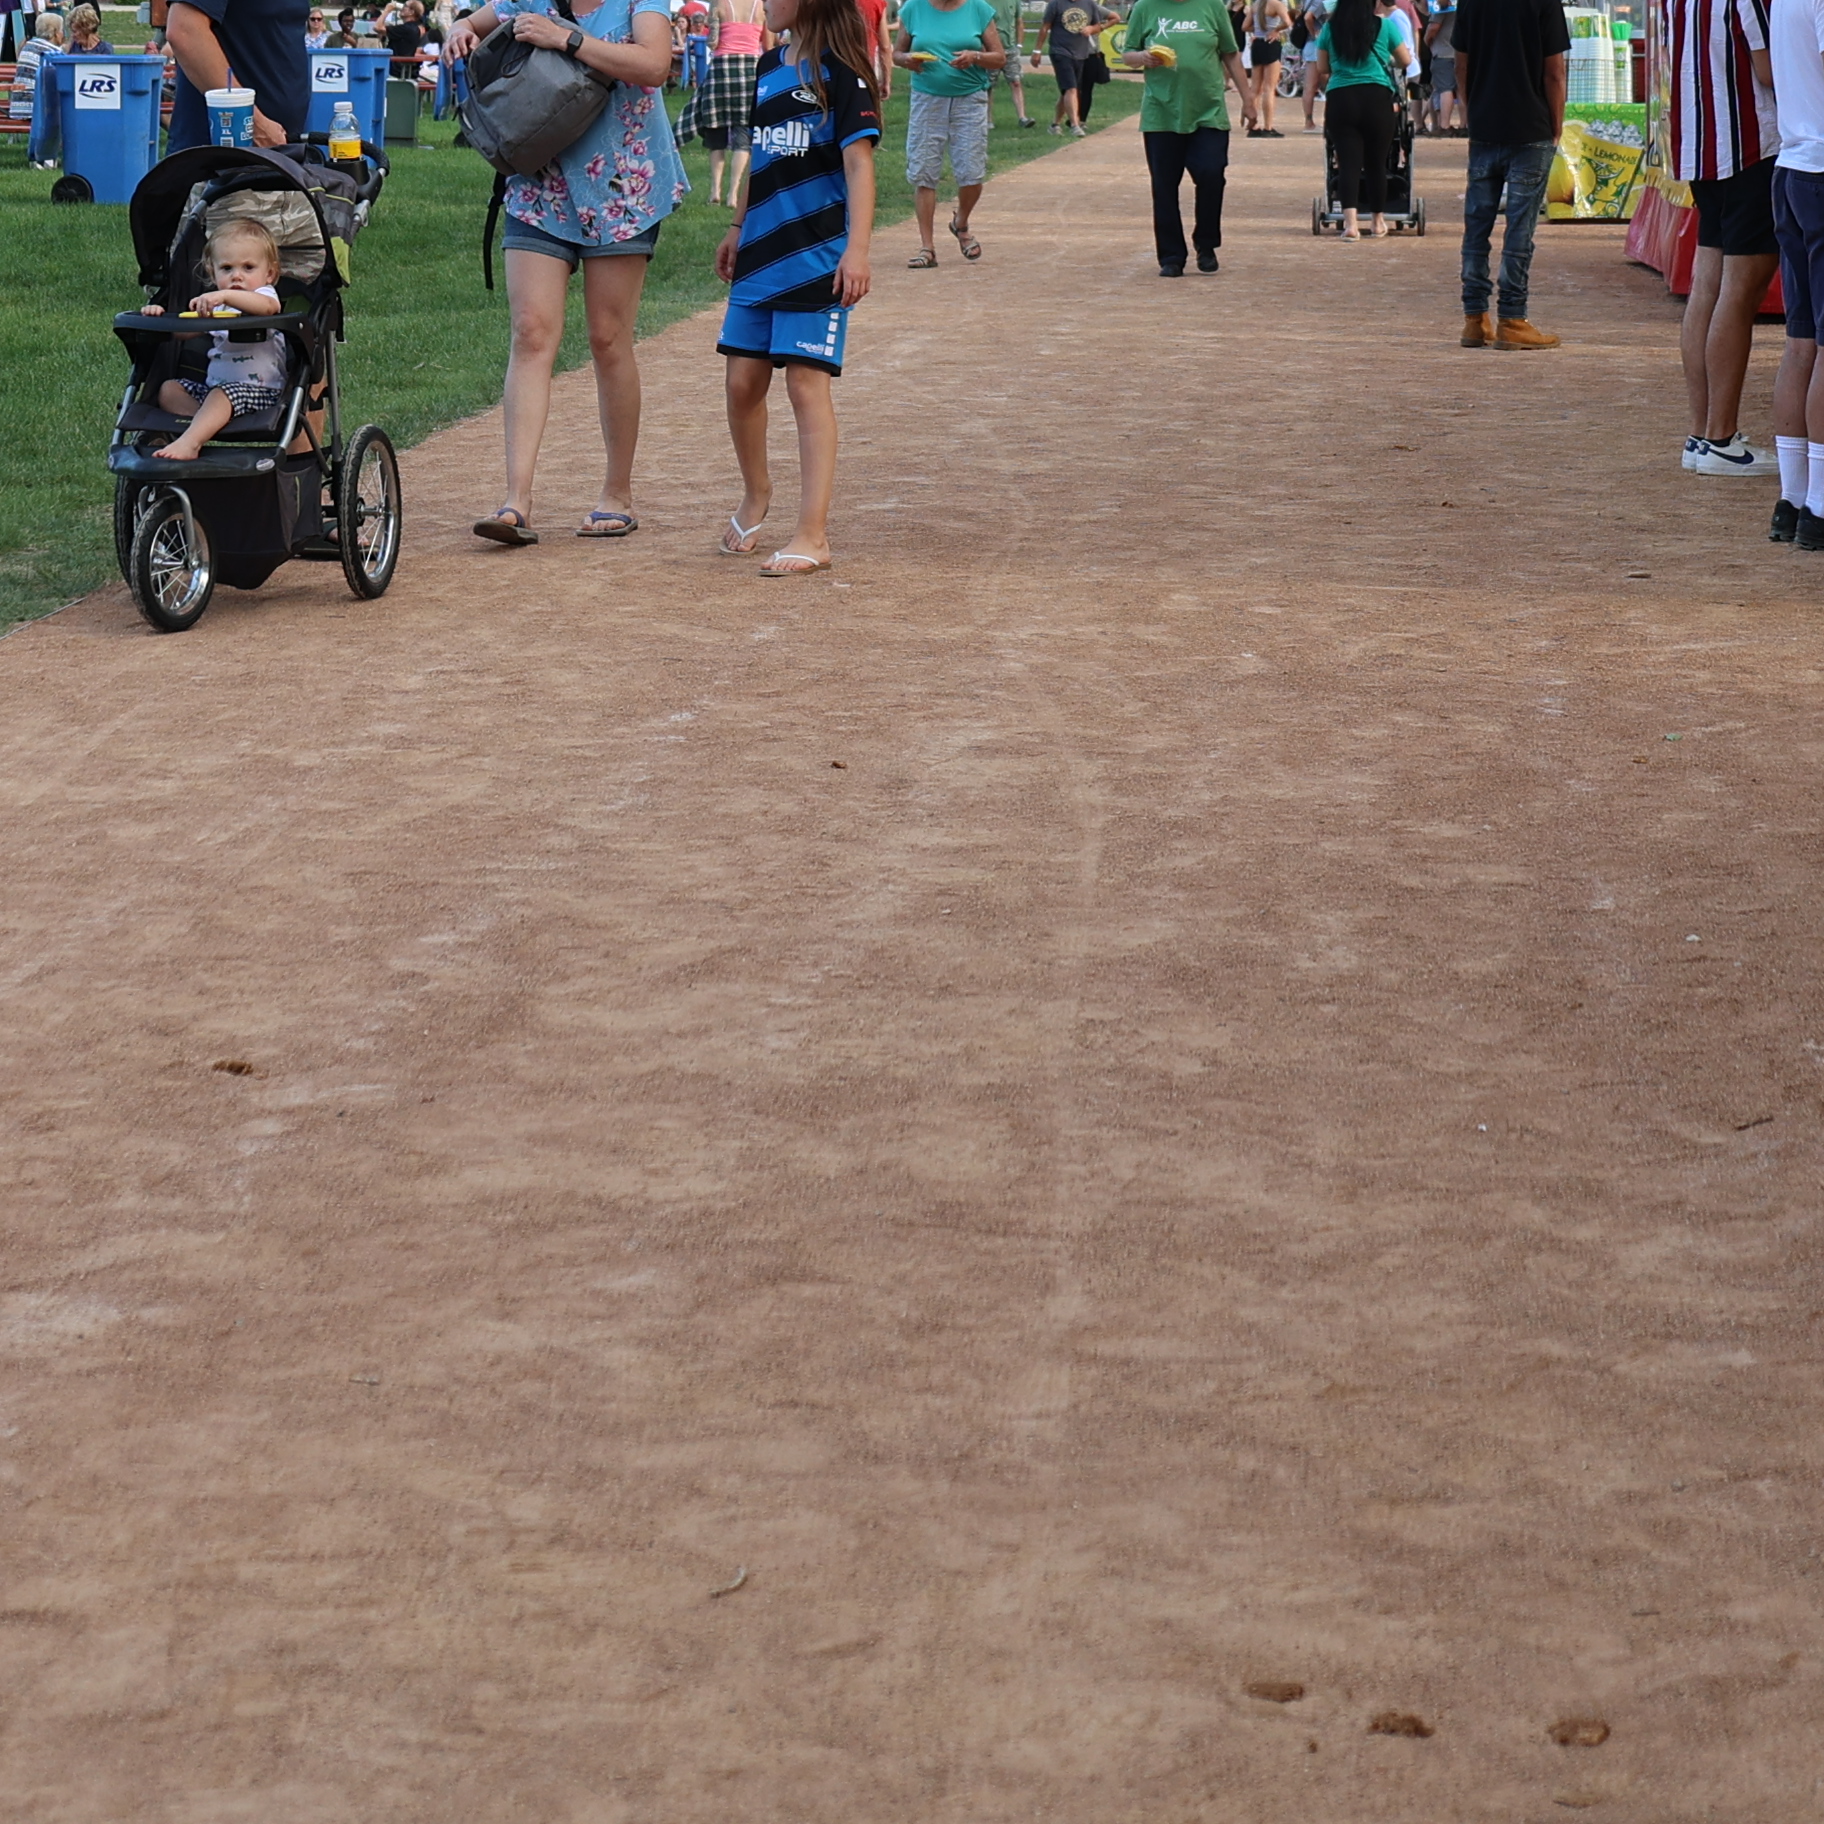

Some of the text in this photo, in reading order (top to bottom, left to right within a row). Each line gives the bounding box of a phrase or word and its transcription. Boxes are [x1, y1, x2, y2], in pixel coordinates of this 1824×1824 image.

[1172, 20, 1198, 30] ABC
[315, 67, 345, 79] LRS
[78, 77, 118, 96] LRS
[767, 145, 808, 157] SPORT
